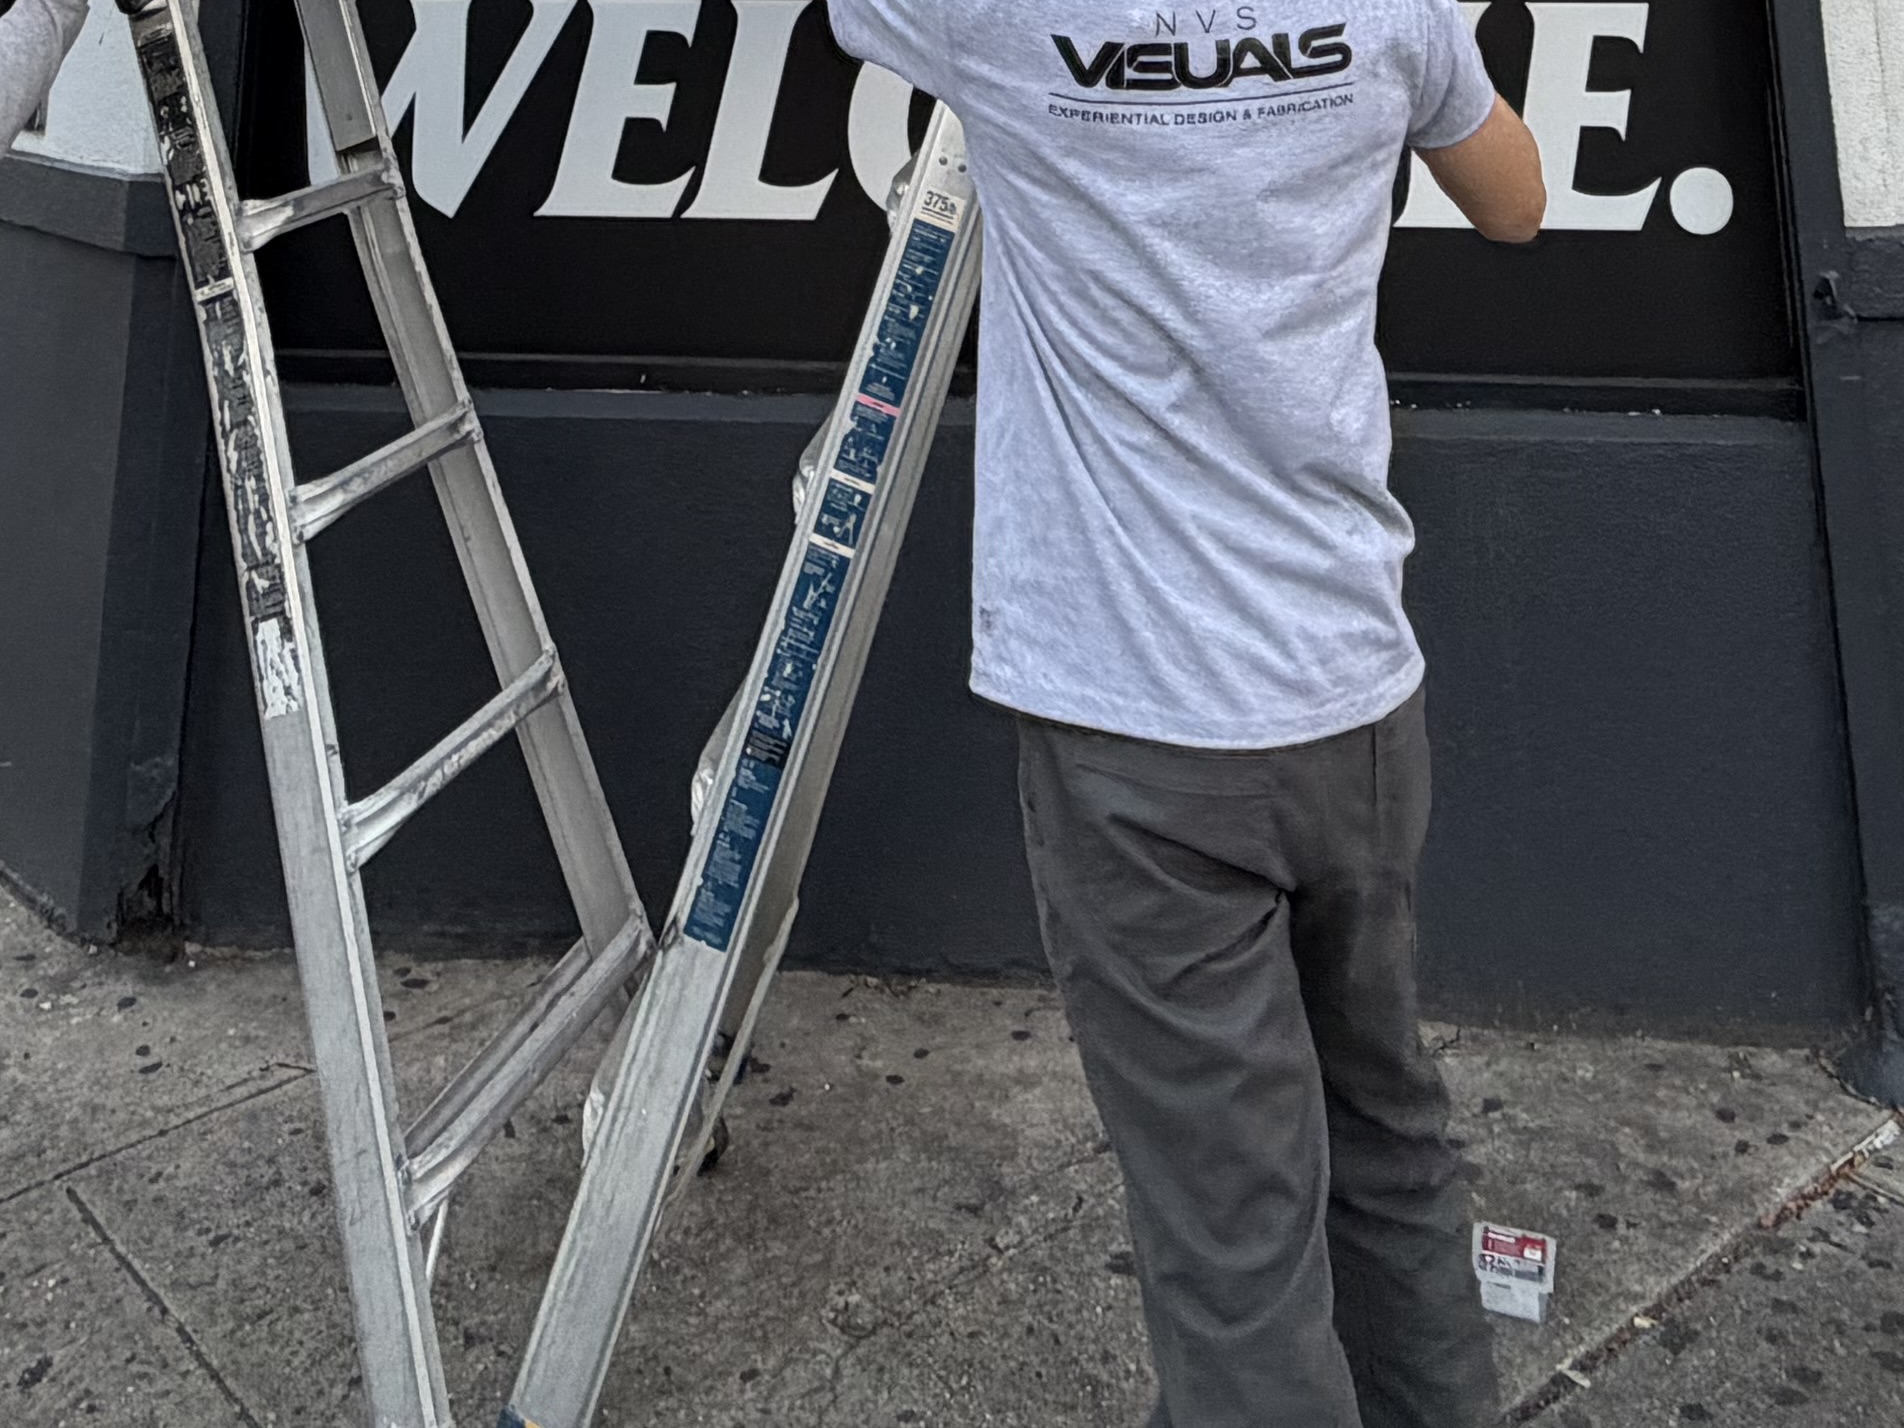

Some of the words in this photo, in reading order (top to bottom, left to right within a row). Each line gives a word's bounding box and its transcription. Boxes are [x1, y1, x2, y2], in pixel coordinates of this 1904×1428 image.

[1049, 21, 1353, 91] VISUALS
[1048, 103, 1170, 126] EXPERIENTIAL
[1174, 109, 1238, 126] DESIGN
[1257, 93, 1355, 120] FABRICATION
